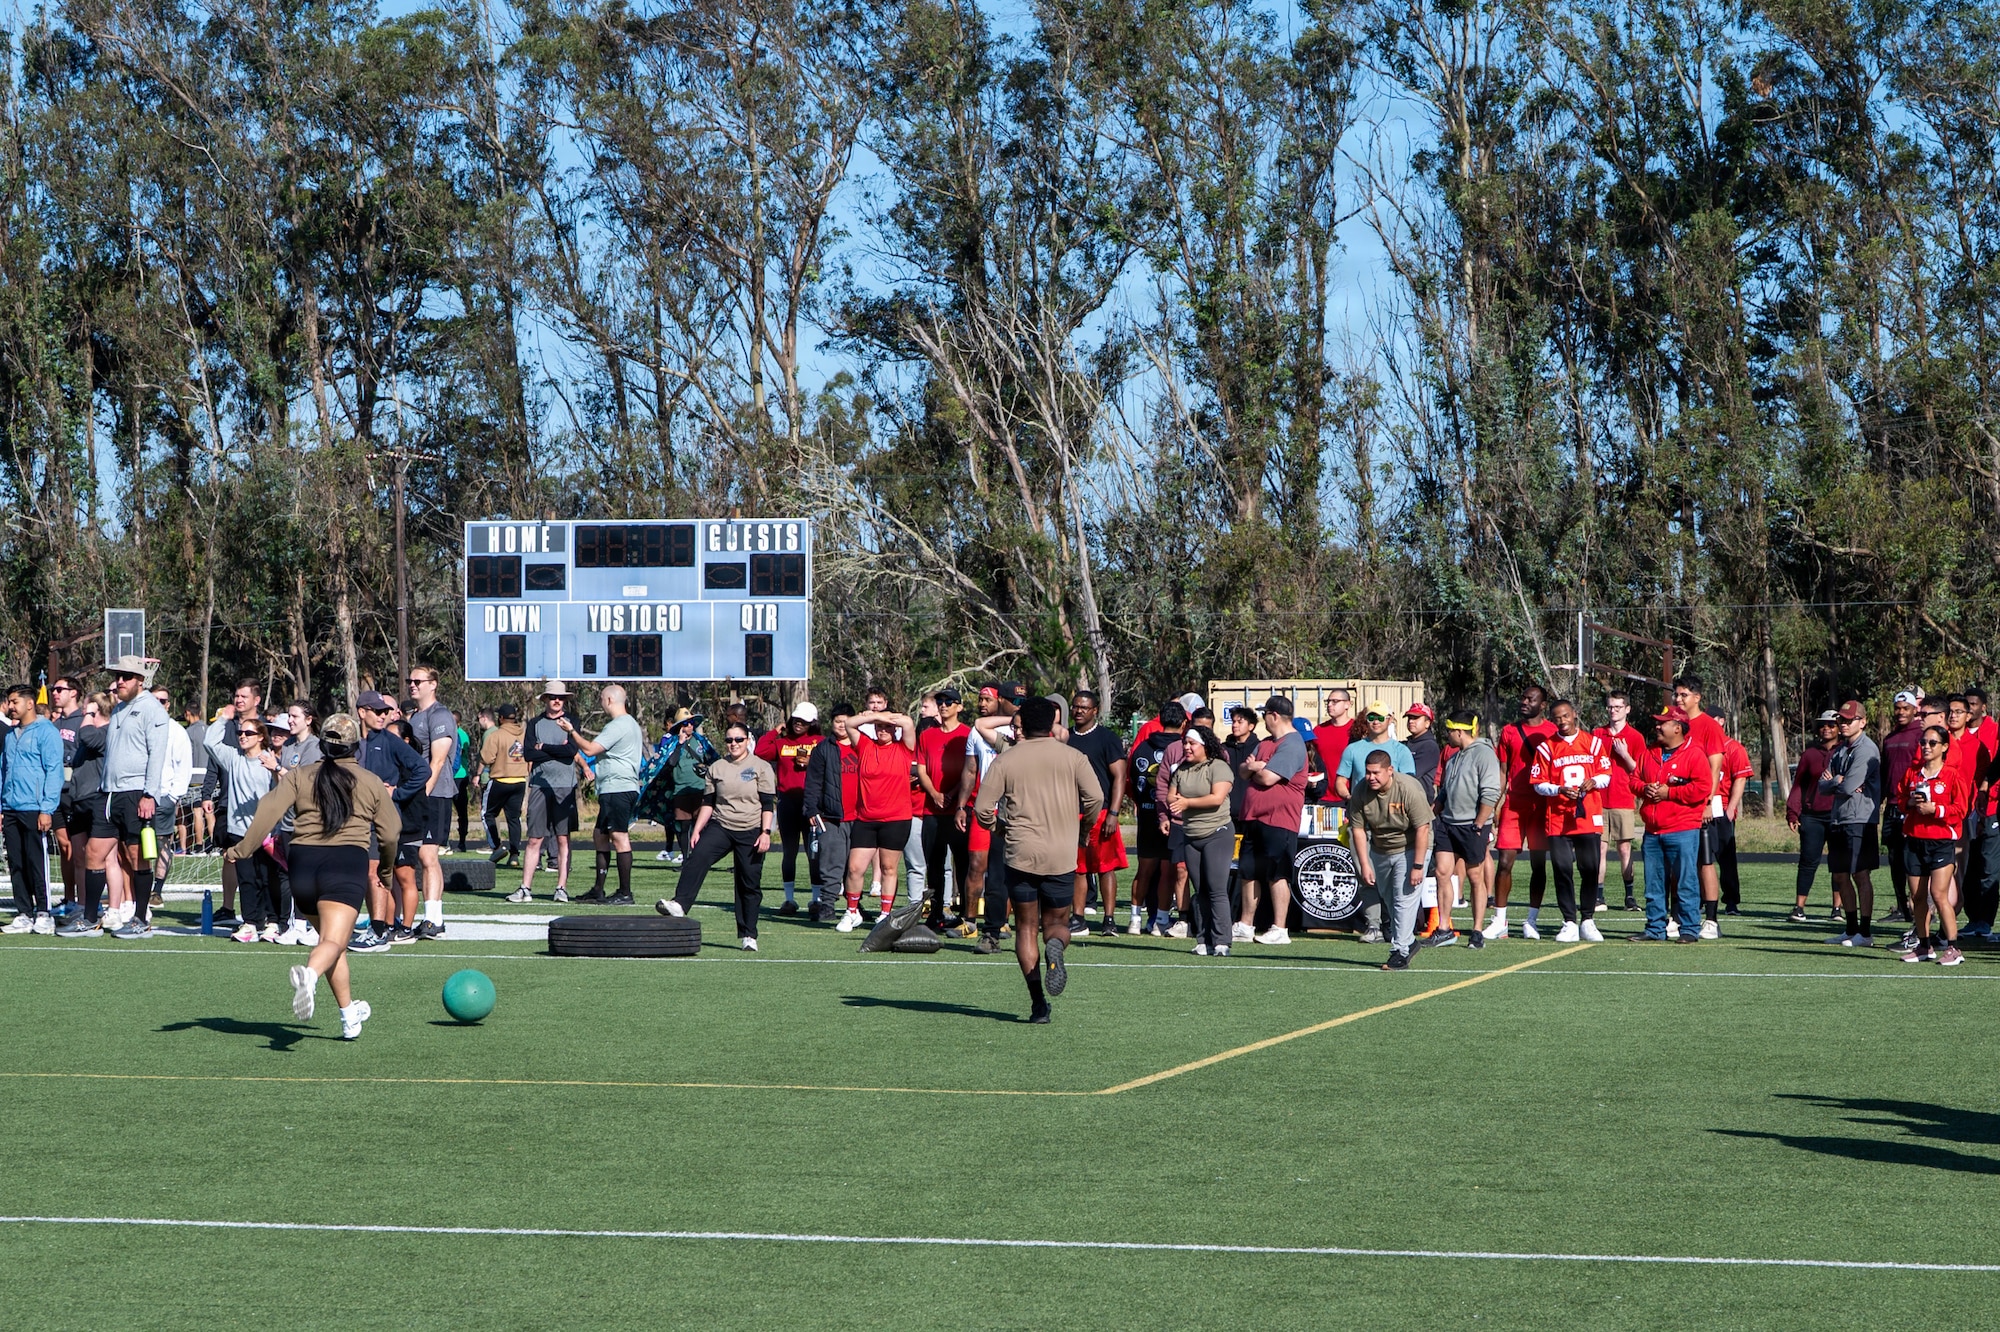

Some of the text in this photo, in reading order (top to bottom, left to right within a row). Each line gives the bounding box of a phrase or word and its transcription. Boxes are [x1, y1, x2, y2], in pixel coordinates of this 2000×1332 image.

[488, 526, 550, 553] HOME
[709, 523, 798, 551] GUESTS
[484, 605, 541, 632] DOWN
[588, 604, 681, 632] YDS TO GO
[741, 603, 778, 631] QTR
[1553, 754, 1595, 768] MONARCHS
[1317, 846, 1350, 858] RESILIENCE
